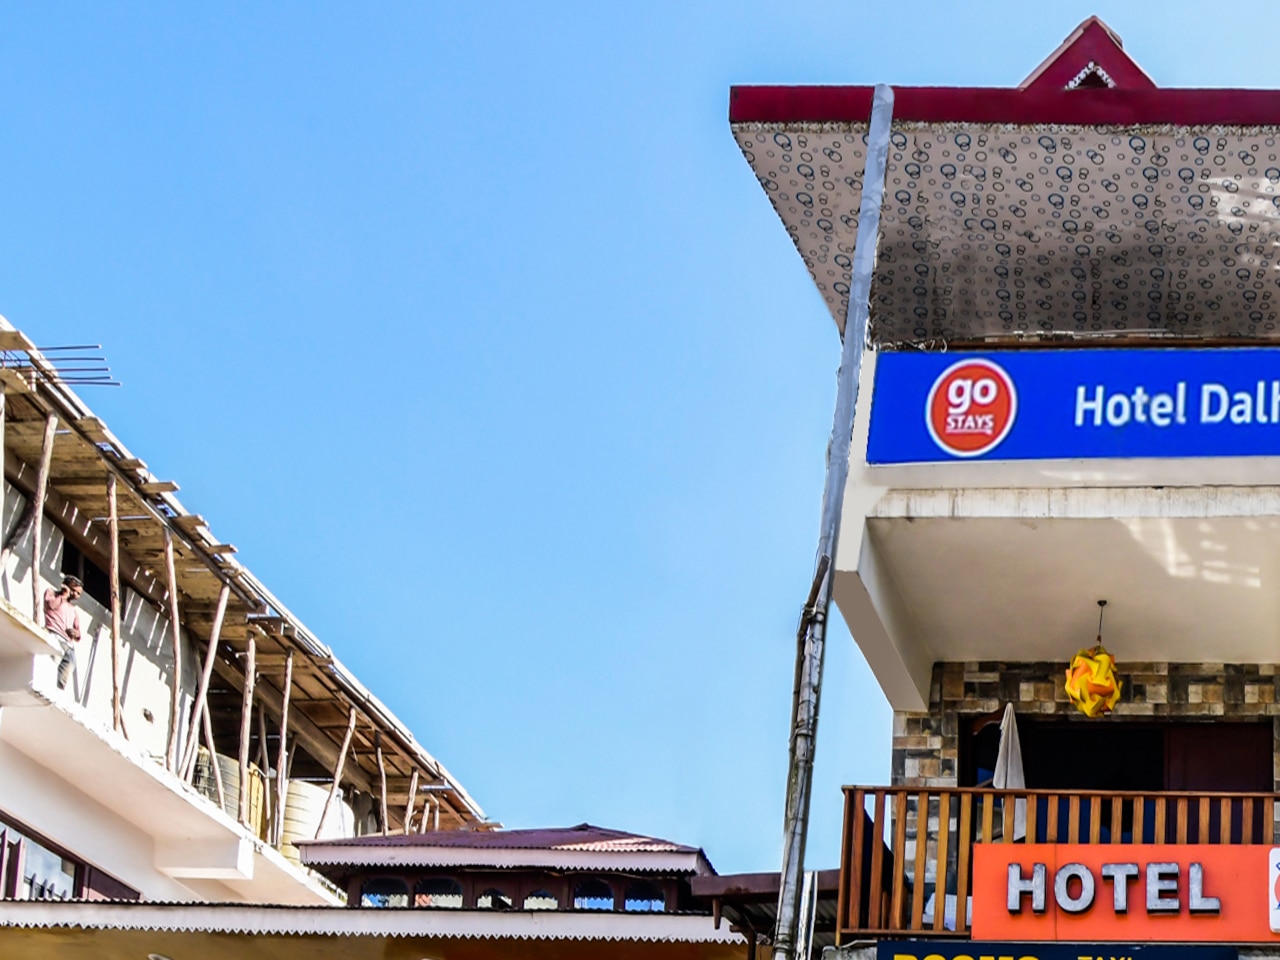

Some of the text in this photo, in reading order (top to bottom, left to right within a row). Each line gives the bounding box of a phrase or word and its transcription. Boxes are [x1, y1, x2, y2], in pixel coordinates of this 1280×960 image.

[947, 377, 998, 415] go
[1074, 381, 1187, 427] Hotel
[946, 414, 994, 431] STAYS
[1006, 862, 1222, 915] HOTEL
